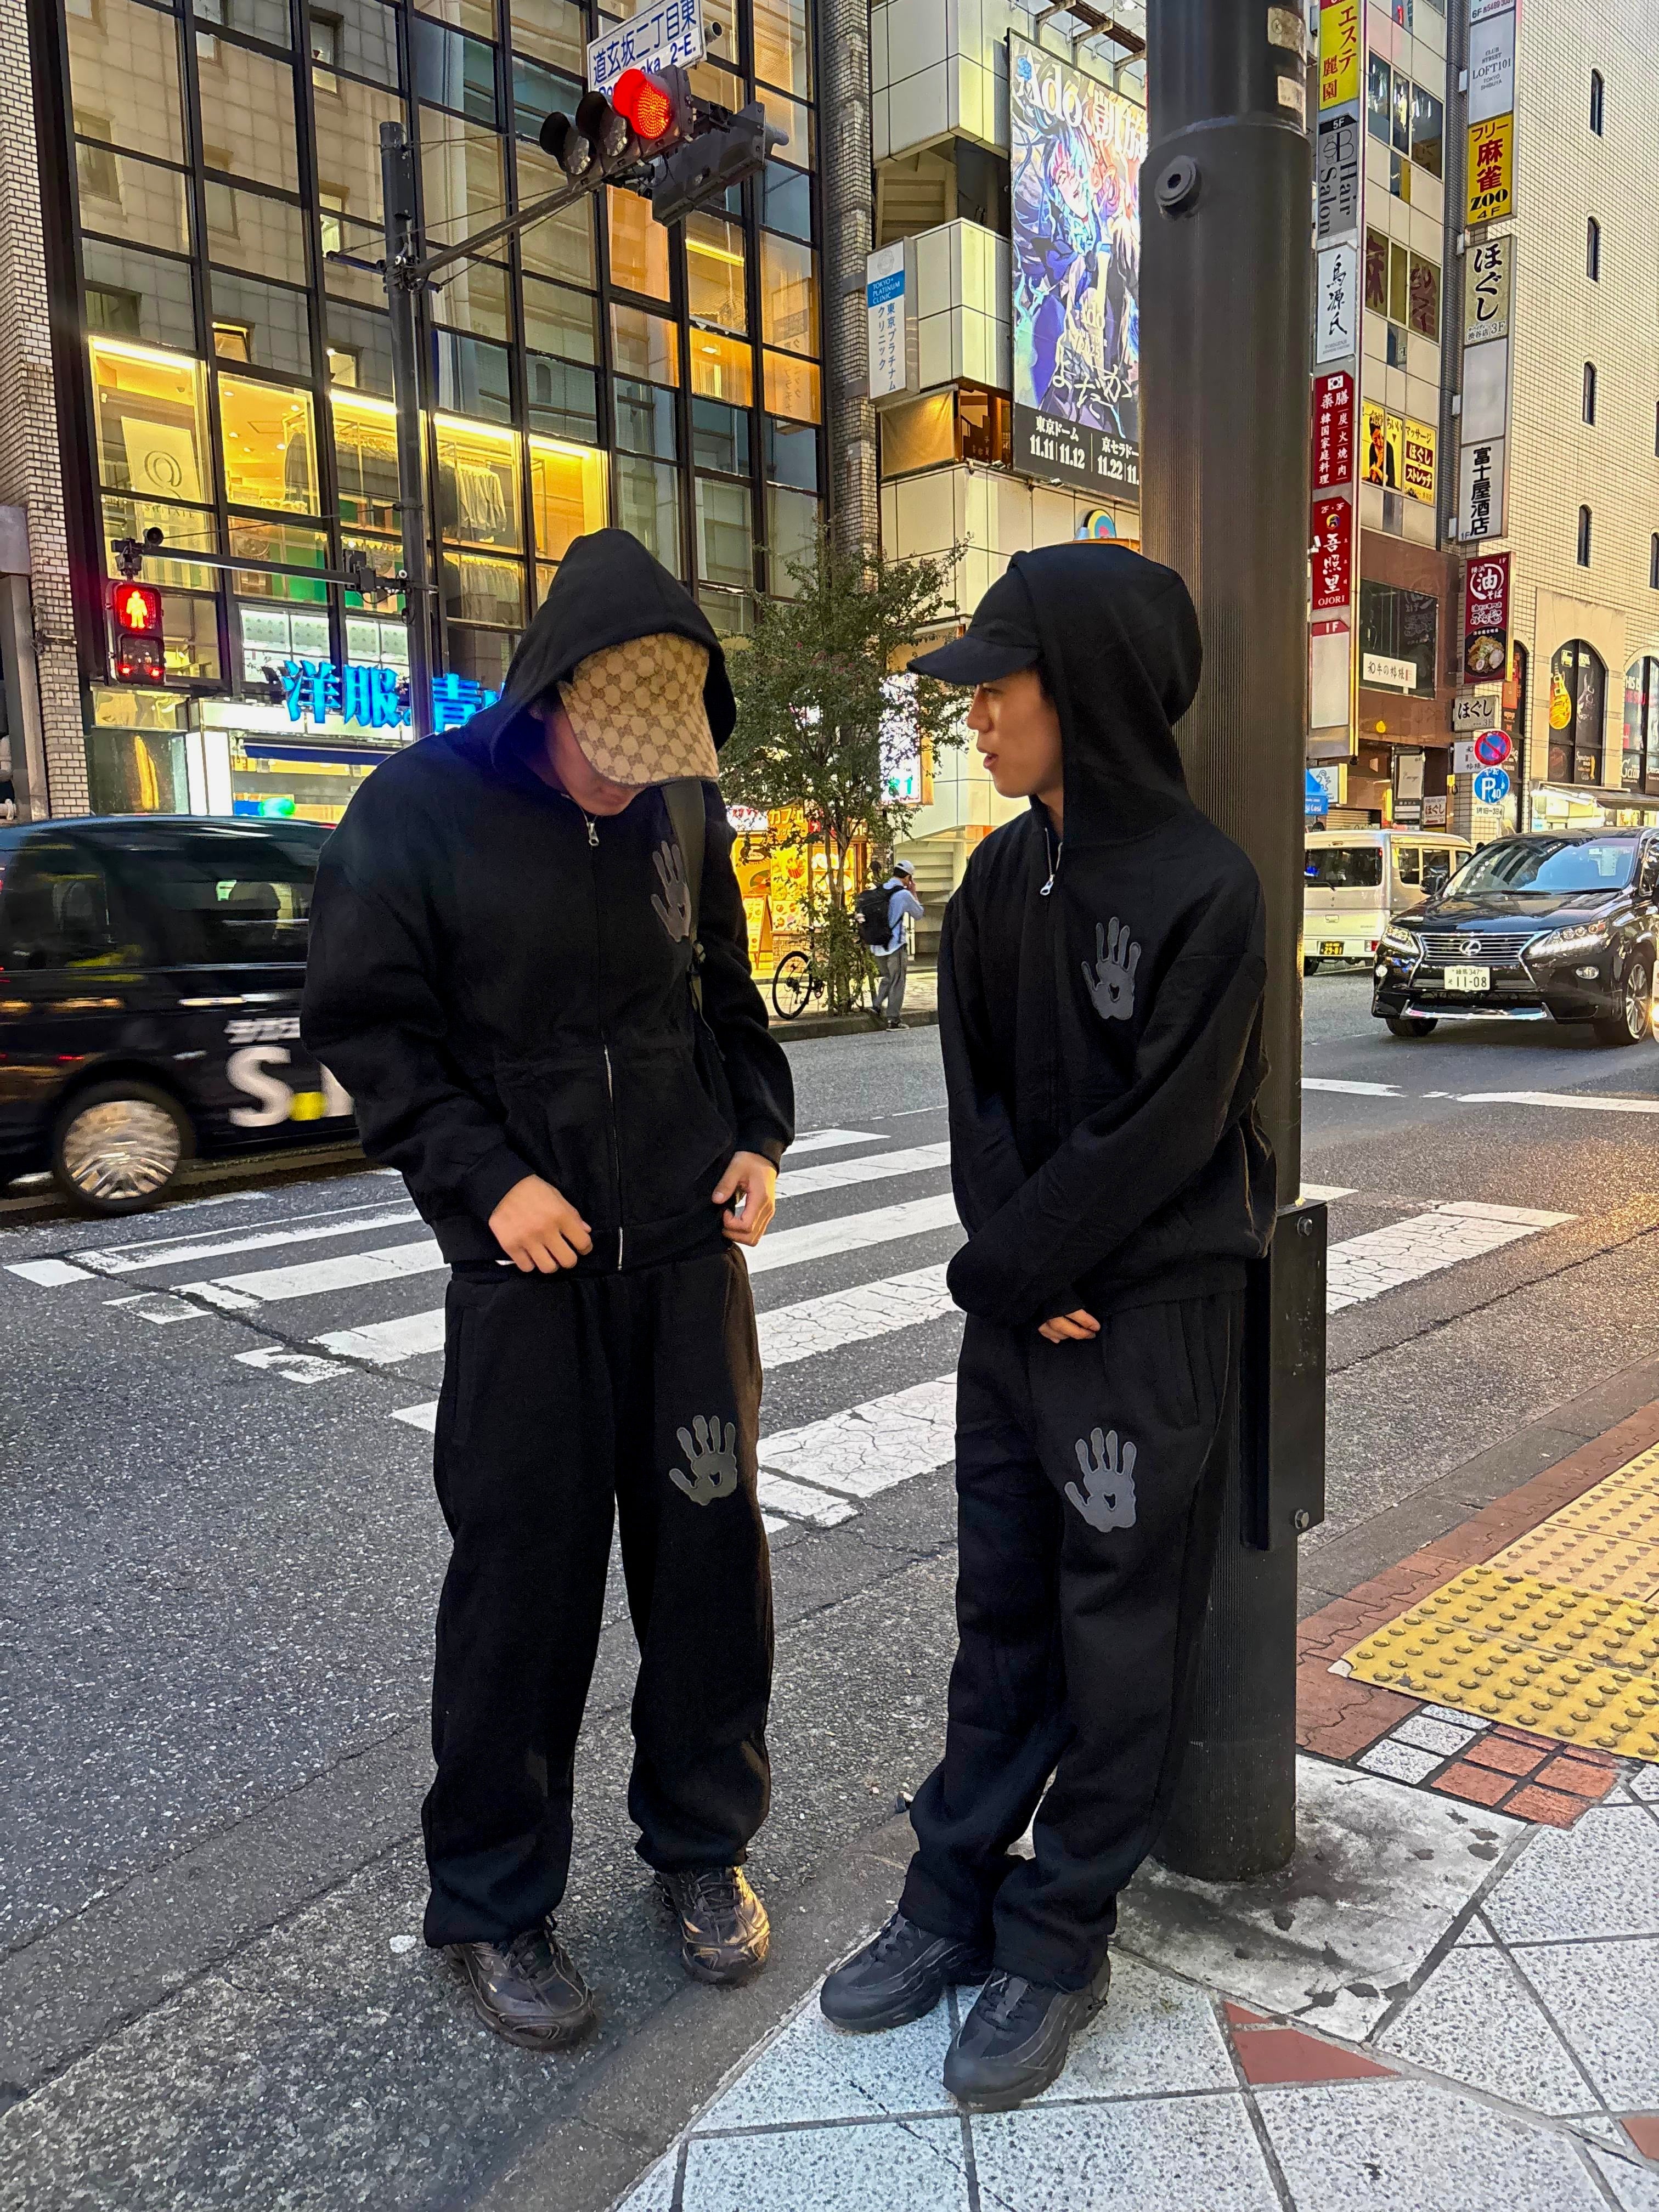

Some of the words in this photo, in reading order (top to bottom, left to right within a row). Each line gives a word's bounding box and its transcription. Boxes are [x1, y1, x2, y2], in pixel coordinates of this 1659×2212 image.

[1472, 8, 1482, 19] 6F
[593, 0, 697, 86] 道玄坂二丁目東
[670, 32, 696, 65] 2-E.
[1338, 5, 1357, 75] エステ
[1482, 52, 1503, 64] STREET
[1485, 47, 1499, 56] CLUB
[1323, 55, 1339, 103] 麗園
[1472, 58, 1511, 80] LOFT101
[1483, 74, 1500, 83] TOKYO
[1481, 80, 1503, 91] SHIBUYA
[1333, 117, 1345, 129] 5F
[1471, 122, 1509, 143] フリー
[1476, 138, 1503, 193] 麻雀
[1340, 161, 1357, 216] Hair
[1319, 167, 1338, 235] Salon
[1470, 188, 1508, 212] ZOO
[1477, 205, 1501, 219] 4F
[872, 277, 891, 290] TOKYO
[872, 280, 900, 298] PLATINUM
[1474, 243, 1503, 321] ほぐし
[872, 291, 891, 304] CLINIC
[1491, 320, 1506, 334] 3F
[877, 306, 886, 371] クリニック
[887, 302, 896, 392] 東京プラチナム
[1321, 388, 1350, 409] 薬膳
[1035, 415, 1079, 442] 東京ドーム
[1405, 426, 1432, 444] マッサージ
[1318, 411, 1331, 485] 韓国家庭料理
[1409, 444, 1431, 465] ほぐし
[1030, 434, 1054, 460] 11.11
[1059, 443, 1086, 470] 11.12
[1097, 454, 1124, 481] 11.22
[1127, 464, 1140, 486] 11.
[1406, 467, 1432, 488] ストレッチ
[1470, 446, 1492, 537] 富士屋酒店
[1323, 533, 1342, 595] 吾照里
[1318, 595, 1346, 606] OJORI
[1458, 699, 1493, 720] ほぐし
[1483, 718, 1493, 727] 3F
[1425, 803, 1445, 815] ほぐし
[1457, 976, 1487, 988] 11-08
